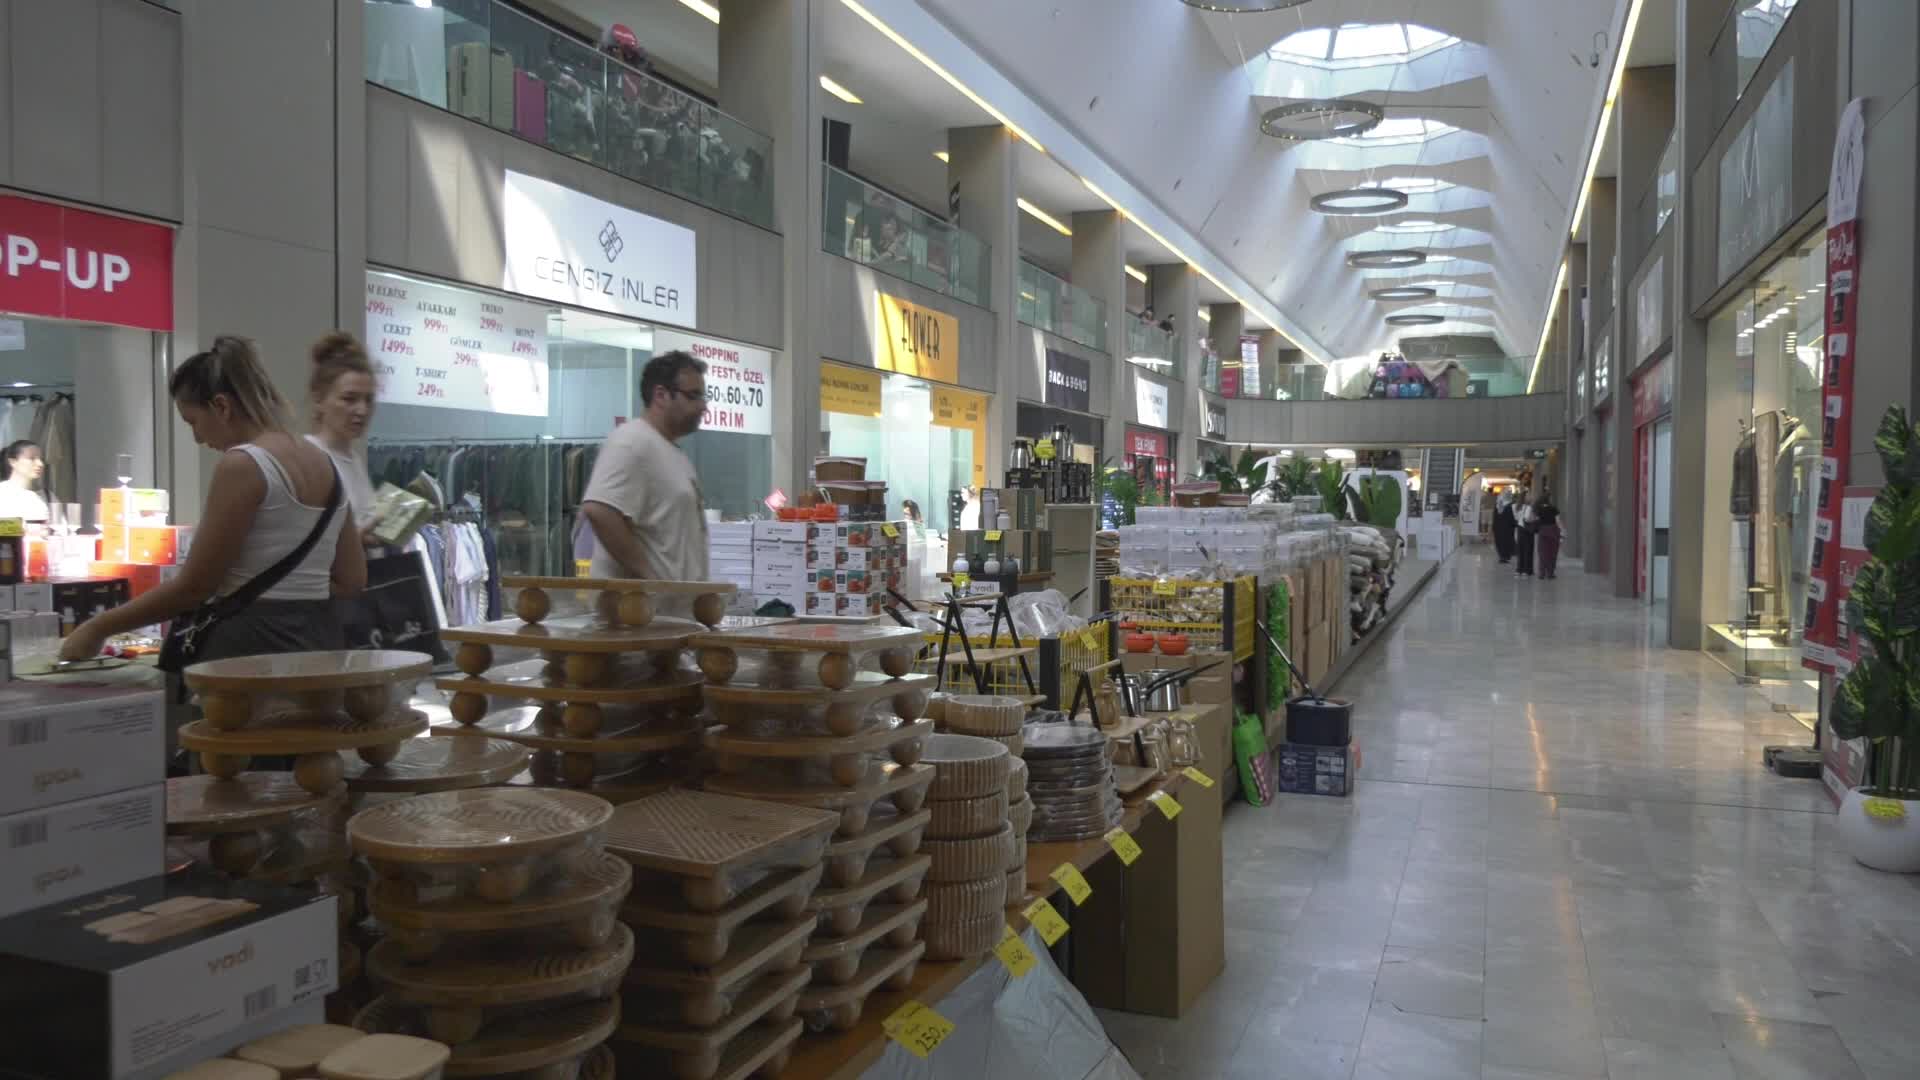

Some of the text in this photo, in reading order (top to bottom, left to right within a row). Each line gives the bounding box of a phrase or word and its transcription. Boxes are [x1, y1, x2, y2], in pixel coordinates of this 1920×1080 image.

[0, 234, 131, 293] P-UP
[383, 323, 412, 336] CEKET
[901, 308, 940, 361] FLOWER
[692, 344, 739, 364] SHOPPING
[415, 367, 447, 380] T-SHIRT
[743, 368, 765, 385] ÖZEL
[1048, 370, 1064, 386] BACK
